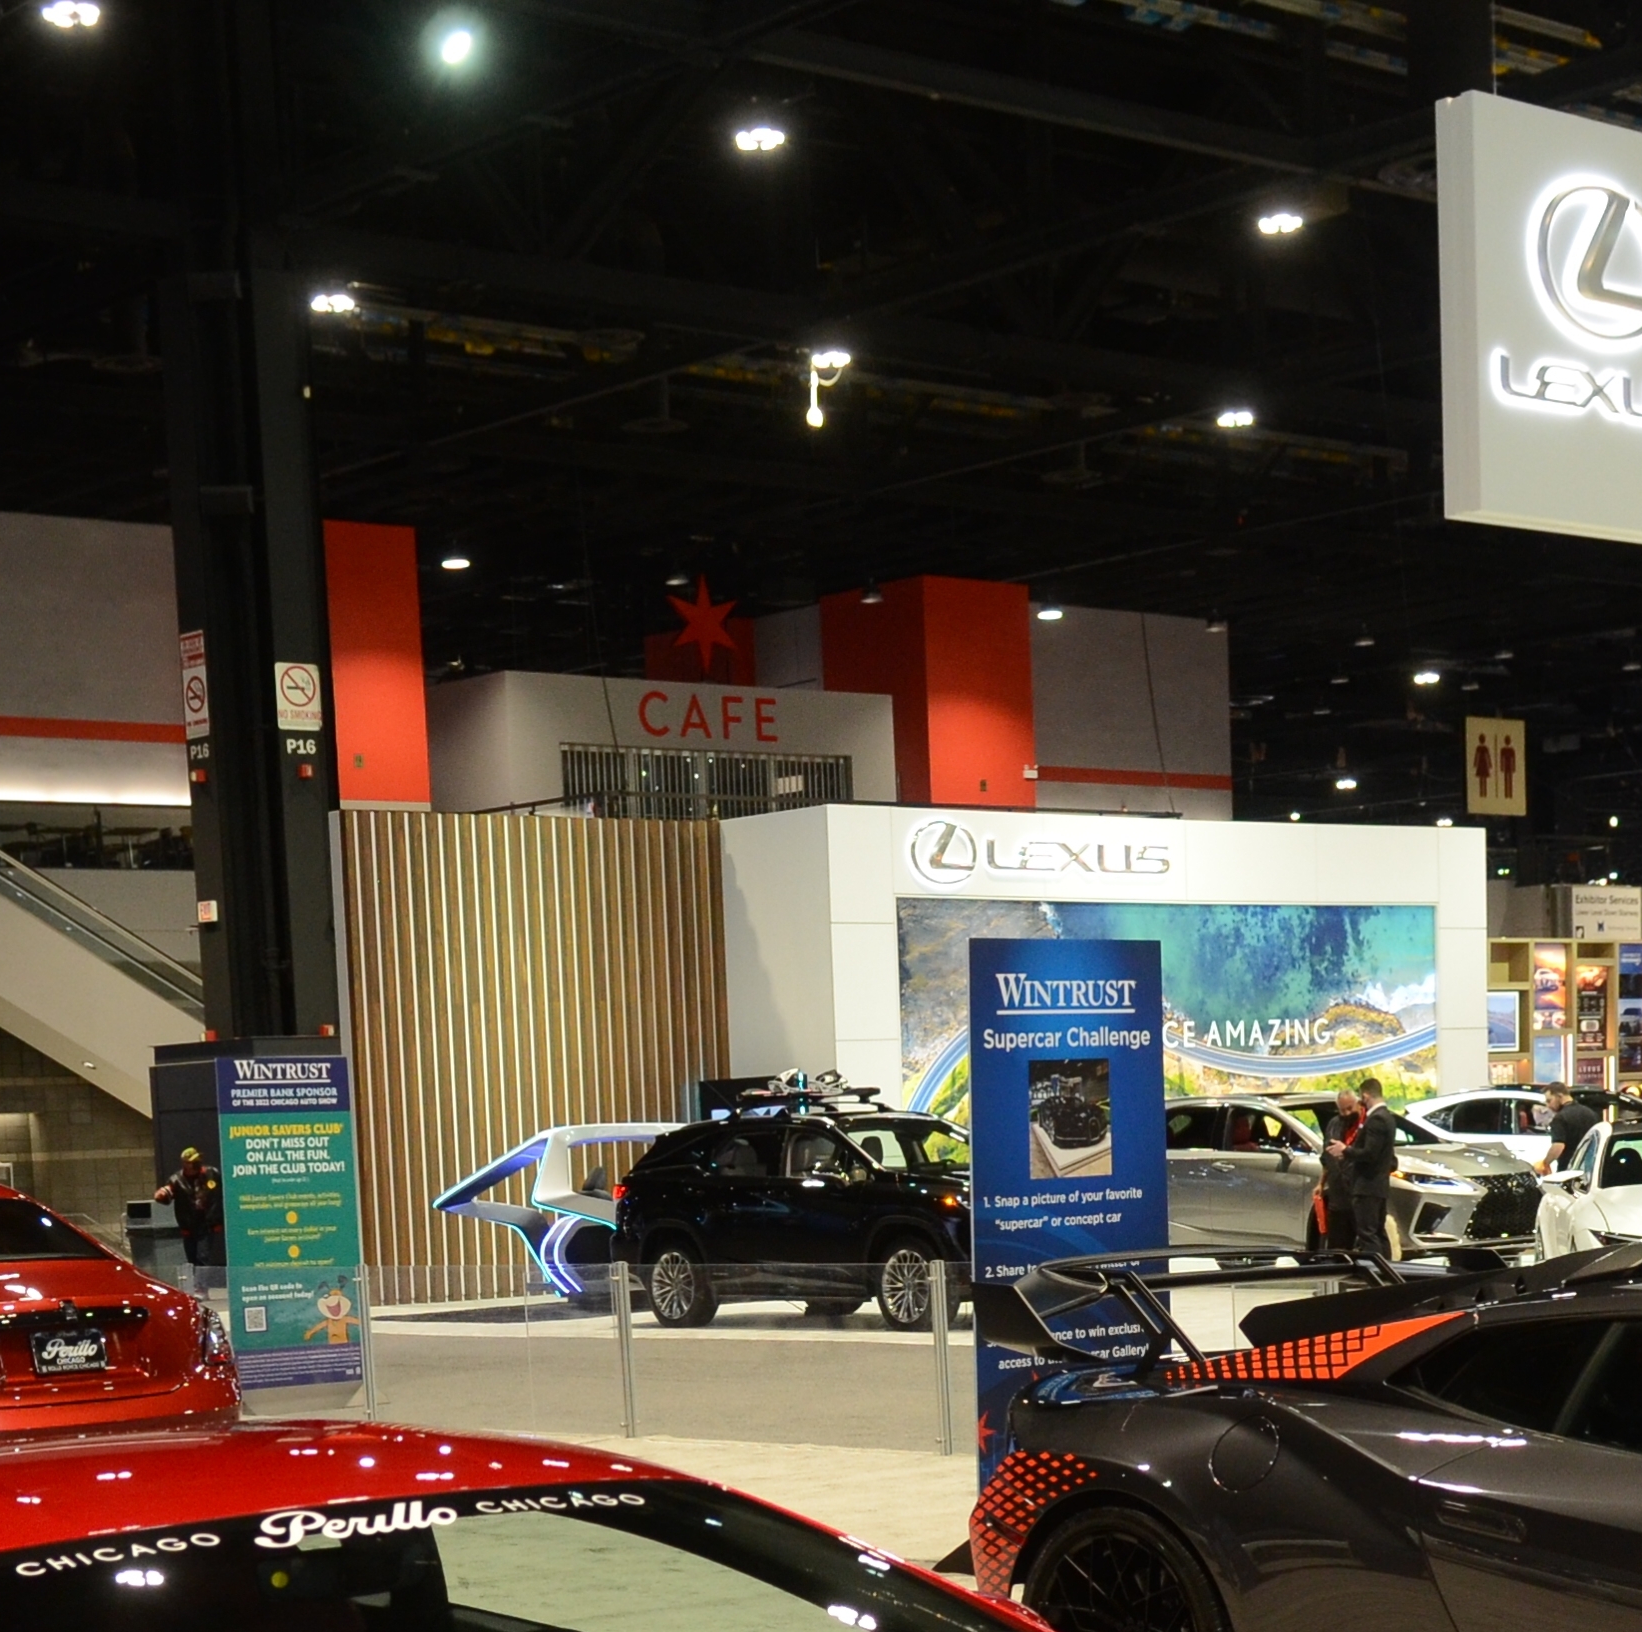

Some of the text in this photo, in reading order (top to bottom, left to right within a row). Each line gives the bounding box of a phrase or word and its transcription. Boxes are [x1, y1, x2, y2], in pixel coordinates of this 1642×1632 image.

[638, 690, 778, 742] CAFE
[190, 743, 209, 759] P16
[286, 738, 316, 754] P16
[986, 838, 1170, 874] LEXUS
[995, 973, 1138, 1008] WINTRUST
[983, 1026, 1151, 1052] Supercar Challenge
[1206, 1018, 1331, 1047] AMAZING
[234, 1060, 331, 1079] WINTRUST
[231, 1087, 338, 1098] PREMIER BANK SPONSOR
[270, 1098, 299, 1106] CHICAGO
[229, 1124, 311, 1139] JUNIOR SAVERS
[246, 1137, 330, 1149] DON'T MISS OUT
[246, 1152, 264, 1162] ON
[266, 1151, 284, 1161] ALL
[286, 1150, 305, 1160] THE
[232, 1161, 345, 1178] JOIN THE CLUB TODAY!
[983, 1188, 1143, 1208] 1. Snap a picture of your favorite
[1051, 1216, 1062, 1226] or
[1064, 1214, 1104, 1228] concept
[1106, 1211, 1122, 1223] car
[985, 1264, 1025, 1278] 2. Share
[1075, 1325, 1105, 1338] to win
[41, 1338, 97, 1360] Perillo
[998, 1358, 1032, 1370] access
[1034, 1356, 1045, 1366] to
[15, 1492, 646, 1578] CHICAGO Perillo CHICAGO
